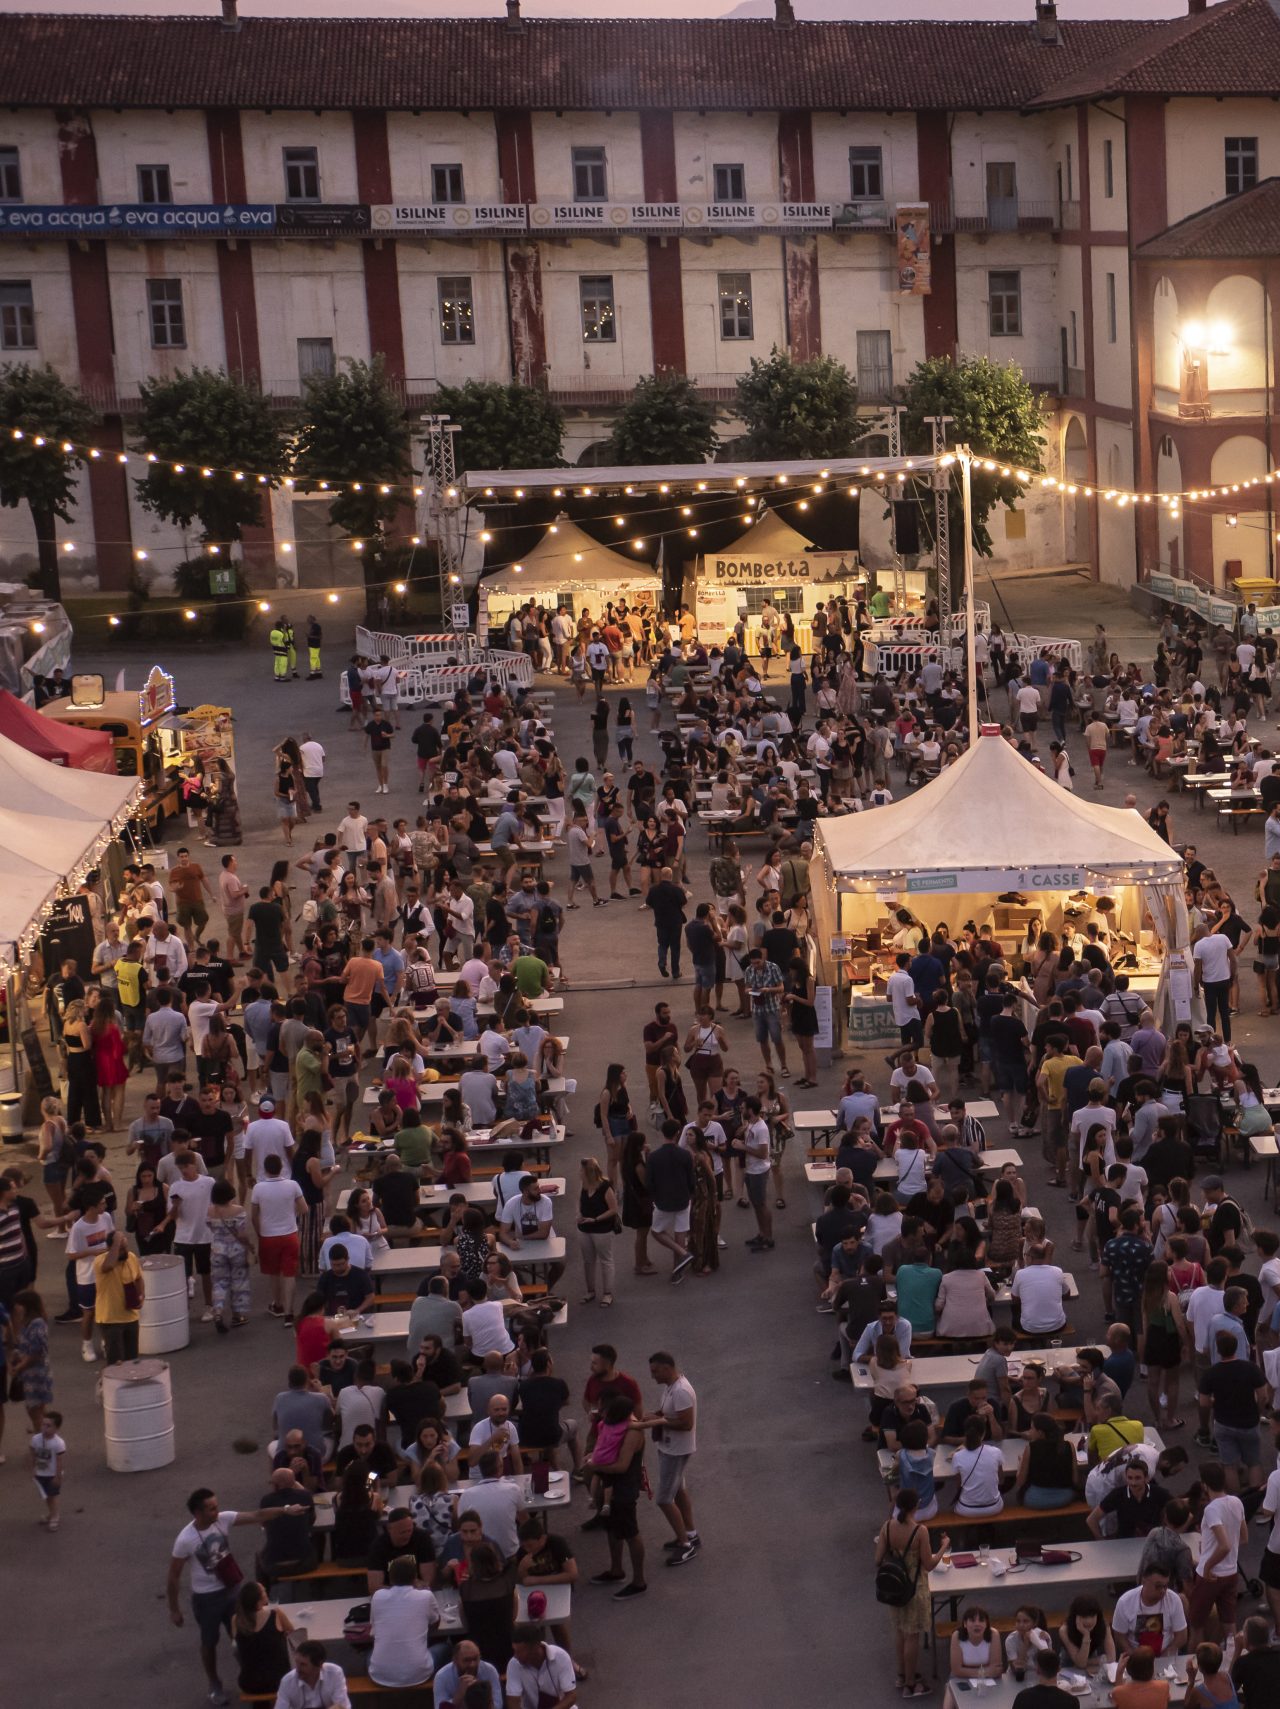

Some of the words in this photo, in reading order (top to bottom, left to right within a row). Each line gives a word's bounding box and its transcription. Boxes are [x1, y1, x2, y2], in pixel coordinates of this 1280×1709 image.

[396, 207, 446, 219] ISILINE
[475, 207, 525, 219] ISILINE
[554, 207, 604, 218] ISILINE
[632, 206, 681, 218] ISILINE
[707, 206, 756, 217] ISILINE
[783, 205, 831, 217] ISILINE
[9, 212, 43, 226] eva
[48, 212, 105, 229] acqua
[125, 211, 159, 225] eva
[163, 211, 220, 228] acqua
[240, 211, 272, 225] eva
[1032, 873, 1080, 886] CASSE
